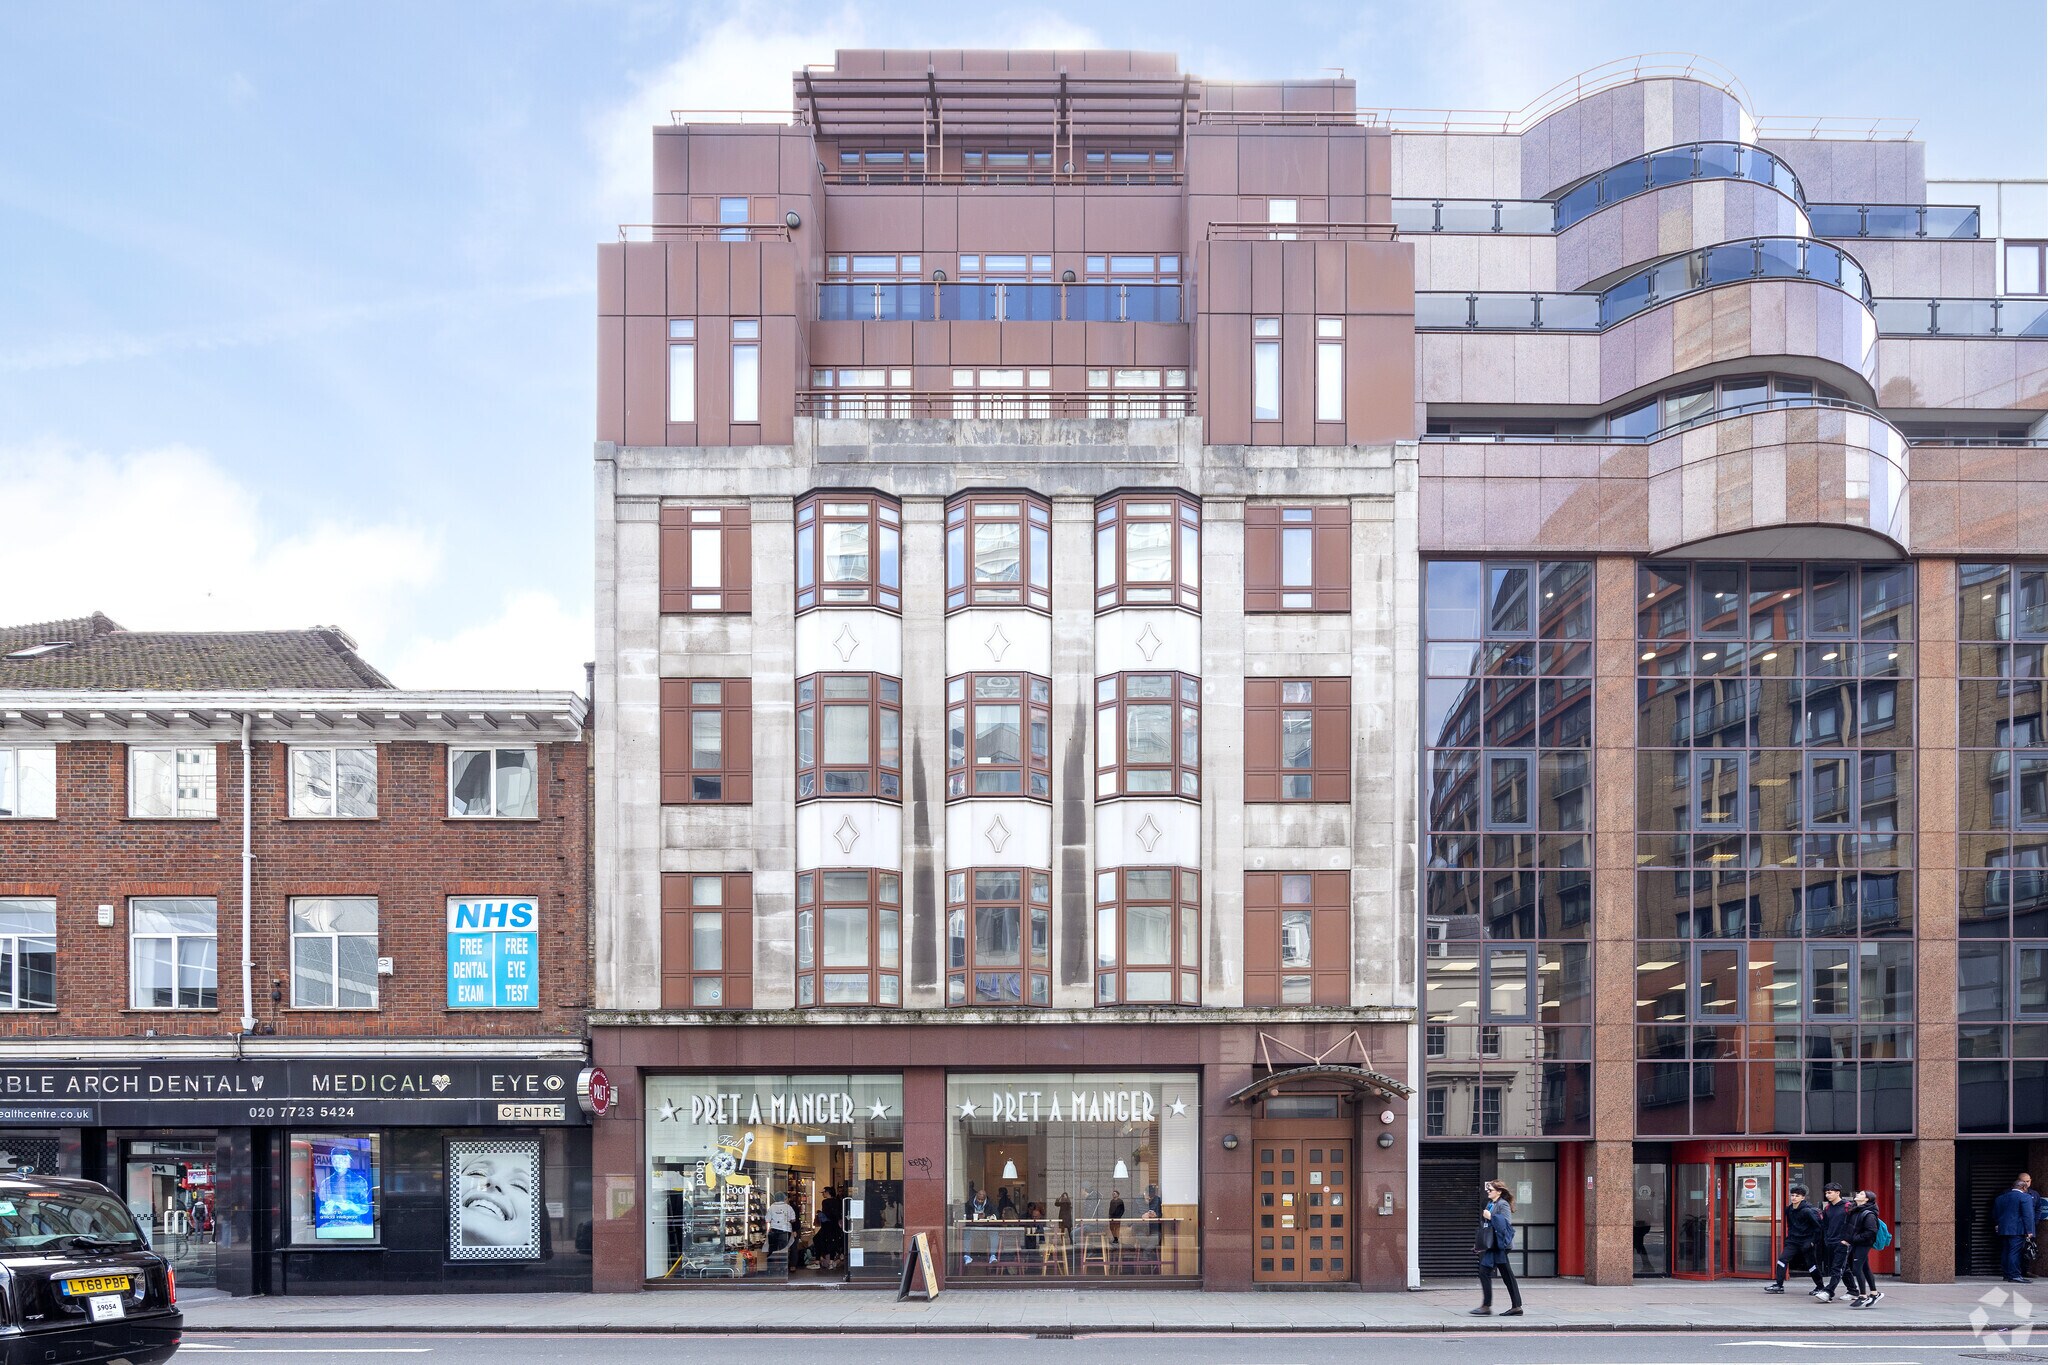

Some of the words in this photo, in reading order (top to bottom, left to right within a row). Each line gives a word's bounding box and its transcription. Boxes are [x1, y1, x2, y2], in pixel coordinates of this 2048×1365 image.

[455, 902, 533, 928] NHS
[459, 938, 483, 955] FREE
[505, 937, 528, 955] FREE
[453, 961, 488, 979] DENTAL
[507, 961, 526, 978] EYE
[458, 985, 484, 1002] EXAM
[505, 985, 529, 1002] TEST
[0, 1075, 54, 1093] BLE
[65, 1075, 138, 1093] ARCH
[149, 1075, 247, 1093] DENTAL
[312, 1074, 431, 1092] MEDICAL
[492, 1074, 540, 1092] EYE
[249, 1107, 275, 1118] 020
[280, 1107, 315, 1118] 7723
[320, 1107, 355, 1118] 5424
[502, 1107, 562, 1118] CENTRE
[691, 1093, 742, 1125] PRET
[748, 1093, 763, 1125] A
[770, 1092, 856, 1125] MANGER
[992, 1091, 1042, 1123] PRET
[1048, 1090, 1063, 1122] A
[1071, 1090, 1155, 1122] MANGER
[718, 1135, 744, 1148] Feel
[696, 1160, 706, 1186] Good
[69, 1279, 102, 1293] LT68
[104, 1277, 126, 1290] PBF
